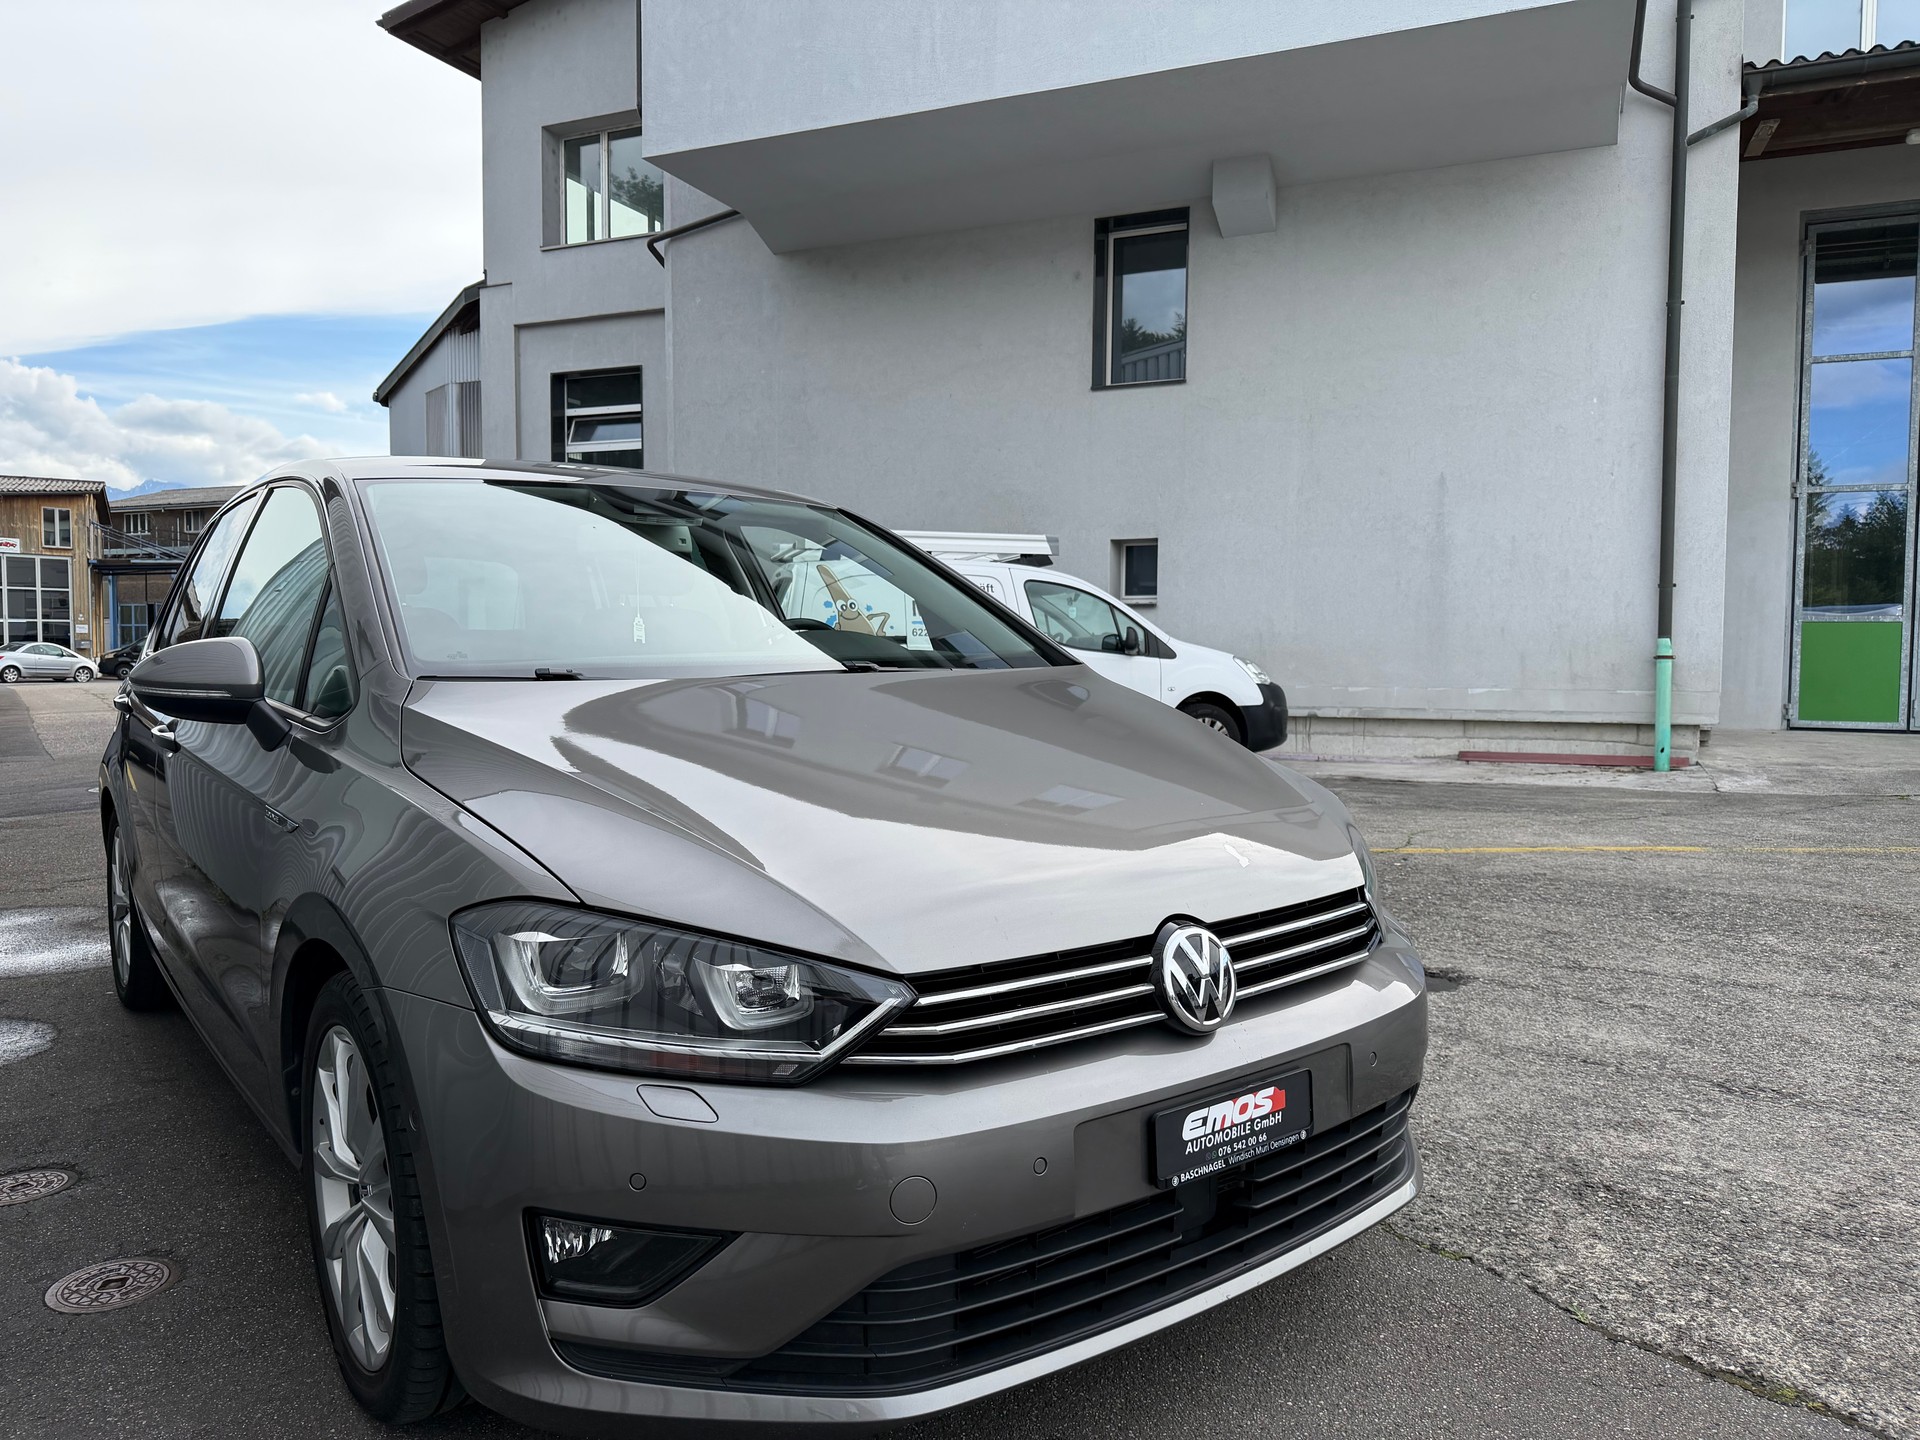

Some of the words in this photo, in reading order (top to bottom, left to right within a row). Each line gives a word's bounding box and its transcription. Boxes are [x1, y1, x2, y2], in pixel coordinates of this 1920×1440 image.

[1163, 926, 1236, 1032] VW
[1185, 1121, 1251, 1155] AUTOMOBILE
[1253, 1111, 1282, 1131] GmbH
[1218, 1144, 1231, 1157] 076
[1233, 1139, 1246, 1152] 542
[1247, 1135, 1257, 1147] 00
[1258, 1132, 1267, 1143] 66
[1180, 1159, 1226, 1183] BASCHNAGEL
[1228, 1149, 1255, 1165] Windisch
[1255, 1142, 1269, 1156] Muri
[1270, 1133, 1300, 1150] Oensingen
